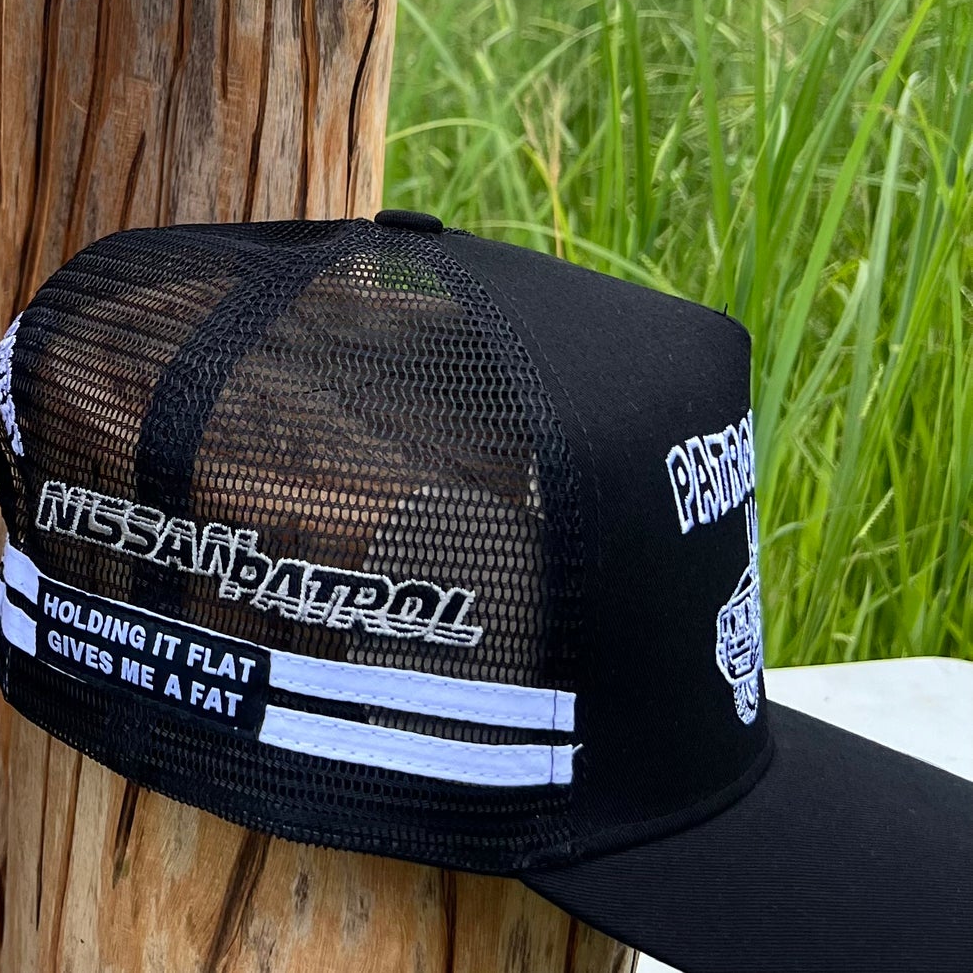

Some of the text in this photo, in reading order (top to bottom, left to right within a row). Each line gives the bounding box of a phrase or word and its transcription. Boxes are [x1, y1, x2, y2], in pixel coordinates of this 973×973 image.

[665, 409, 756, 535] PATRO
[35, 480, 484, 647] NISSAN PATROL
[42, 592, 257, 683] HOLDING IT FLAT
[47, 630, 244, 718] GIVES ME A FAT
